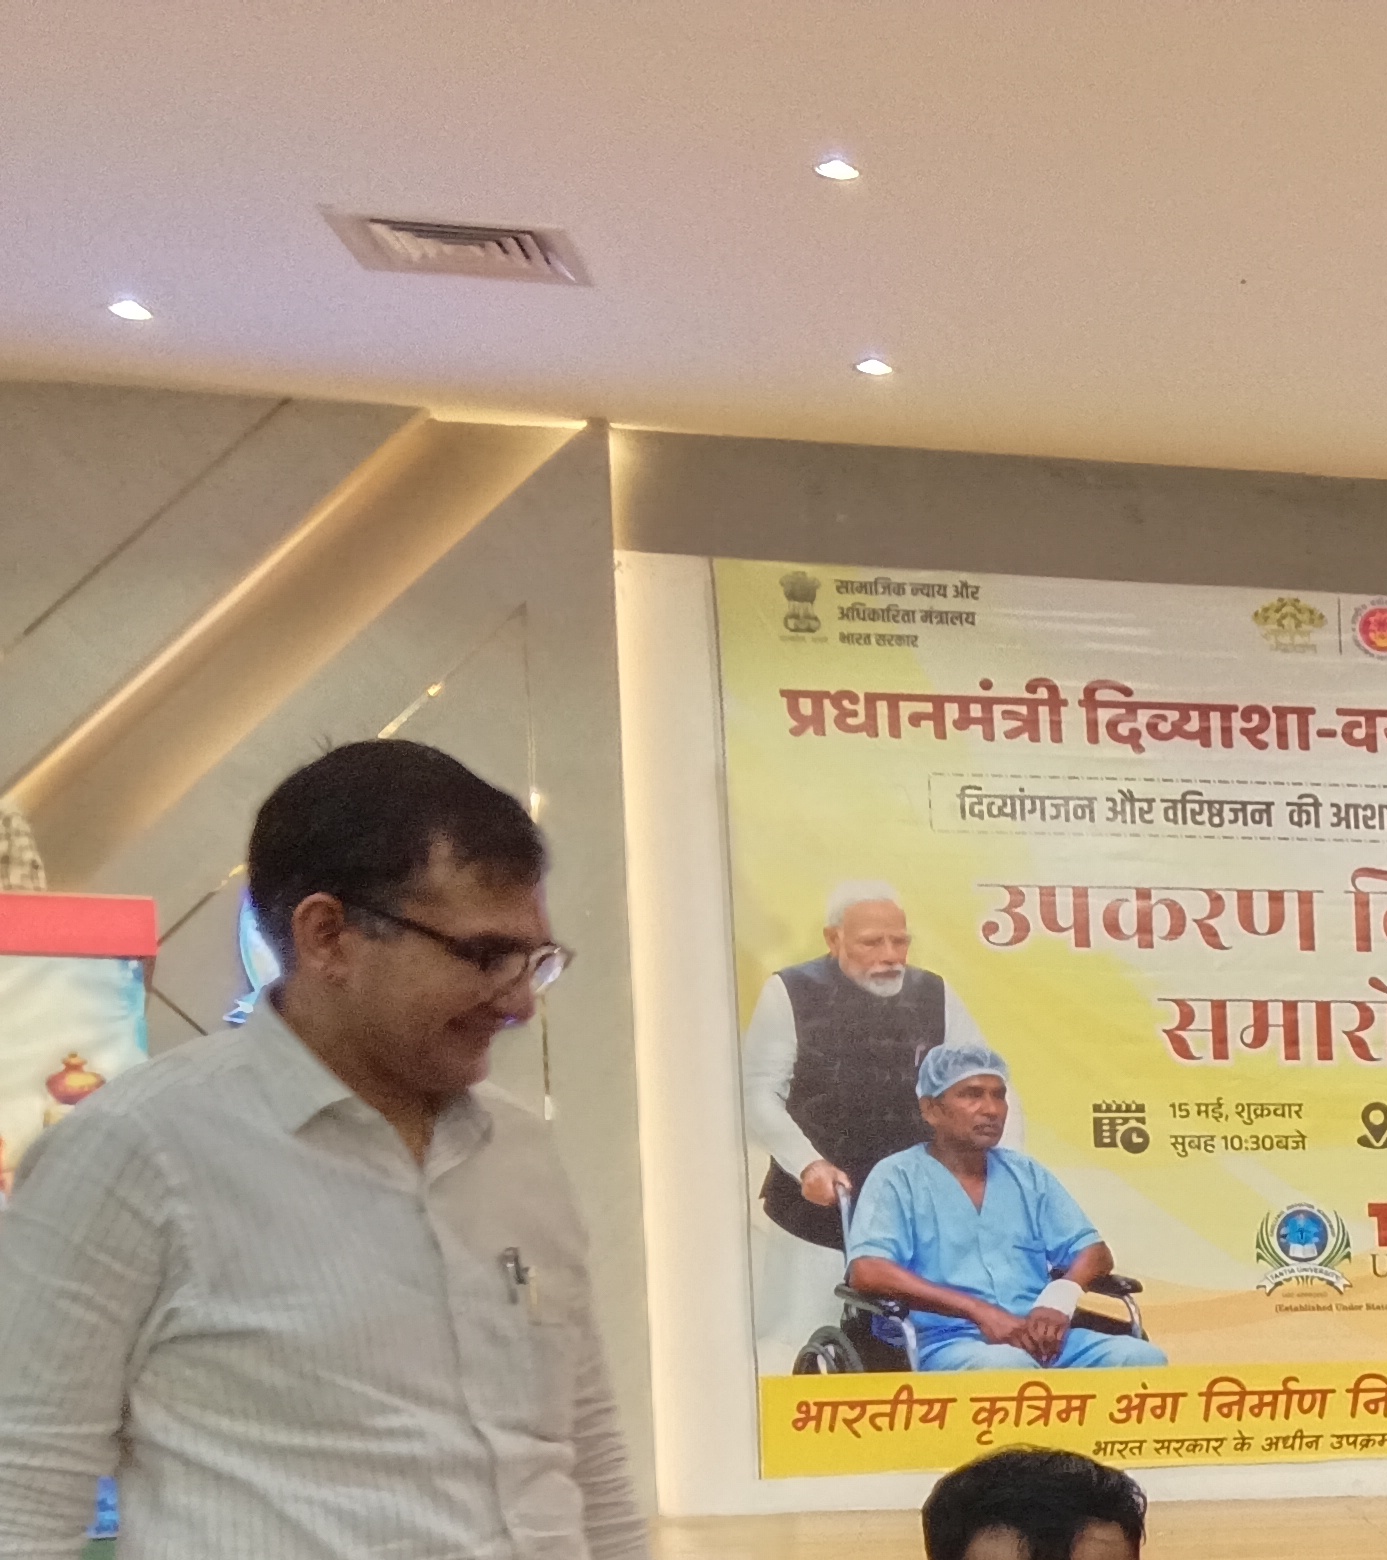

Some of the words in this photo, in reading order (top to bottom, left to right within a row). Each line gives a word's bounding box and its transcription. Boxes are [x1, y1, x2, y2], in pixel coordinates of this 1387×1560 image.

[835, 577, 905, 596] सामाजिक
[911, 582, 948, 599] न्याय
[953, 579, 980, 600] और
[838, 602, 916, 624] अधिकारिता
[920, 606, 976, 626] मंत्रालय
[839, 631, 872, 646] भारत
[874, 632, 919, 648] सरकार
[780, 677, 1068, 744] प्रधानमंत्री
[957, 785, 1098, 824] दिव्यांगजन
[1105, 788, 1155, 826] और
[1163, 789, 1274, 829] वरिष्ठजन
[1286, 793, 1322, 829] की
[976, 883, 1324, 953] उपकरण
[1168, 1104, 1190, 1119] 15
[1195, 1097, 1230, 1123] मई,
[1234, 1102, 1304, 1126] शुक्रवार
[1170, 1133, 1215, 1158] सुबह
[1221, 1129, 1307, 1152] 10:30बजे
[791, 1384, 958, 1439] भारतीय
[969, 1380, 1097, 1446] कृत्रिम
[1109, 1381, 1187, 1426] अंग
[1199, 1375, 1335, 1424] निर्माण
[1093, 1437, 1146, 1458] भारत
[1152, 1433, 1226, 1457] सरकार
[1232, 1432, 1254, 1454] के
[1261, 1429, 1320, 1452] अधीन
